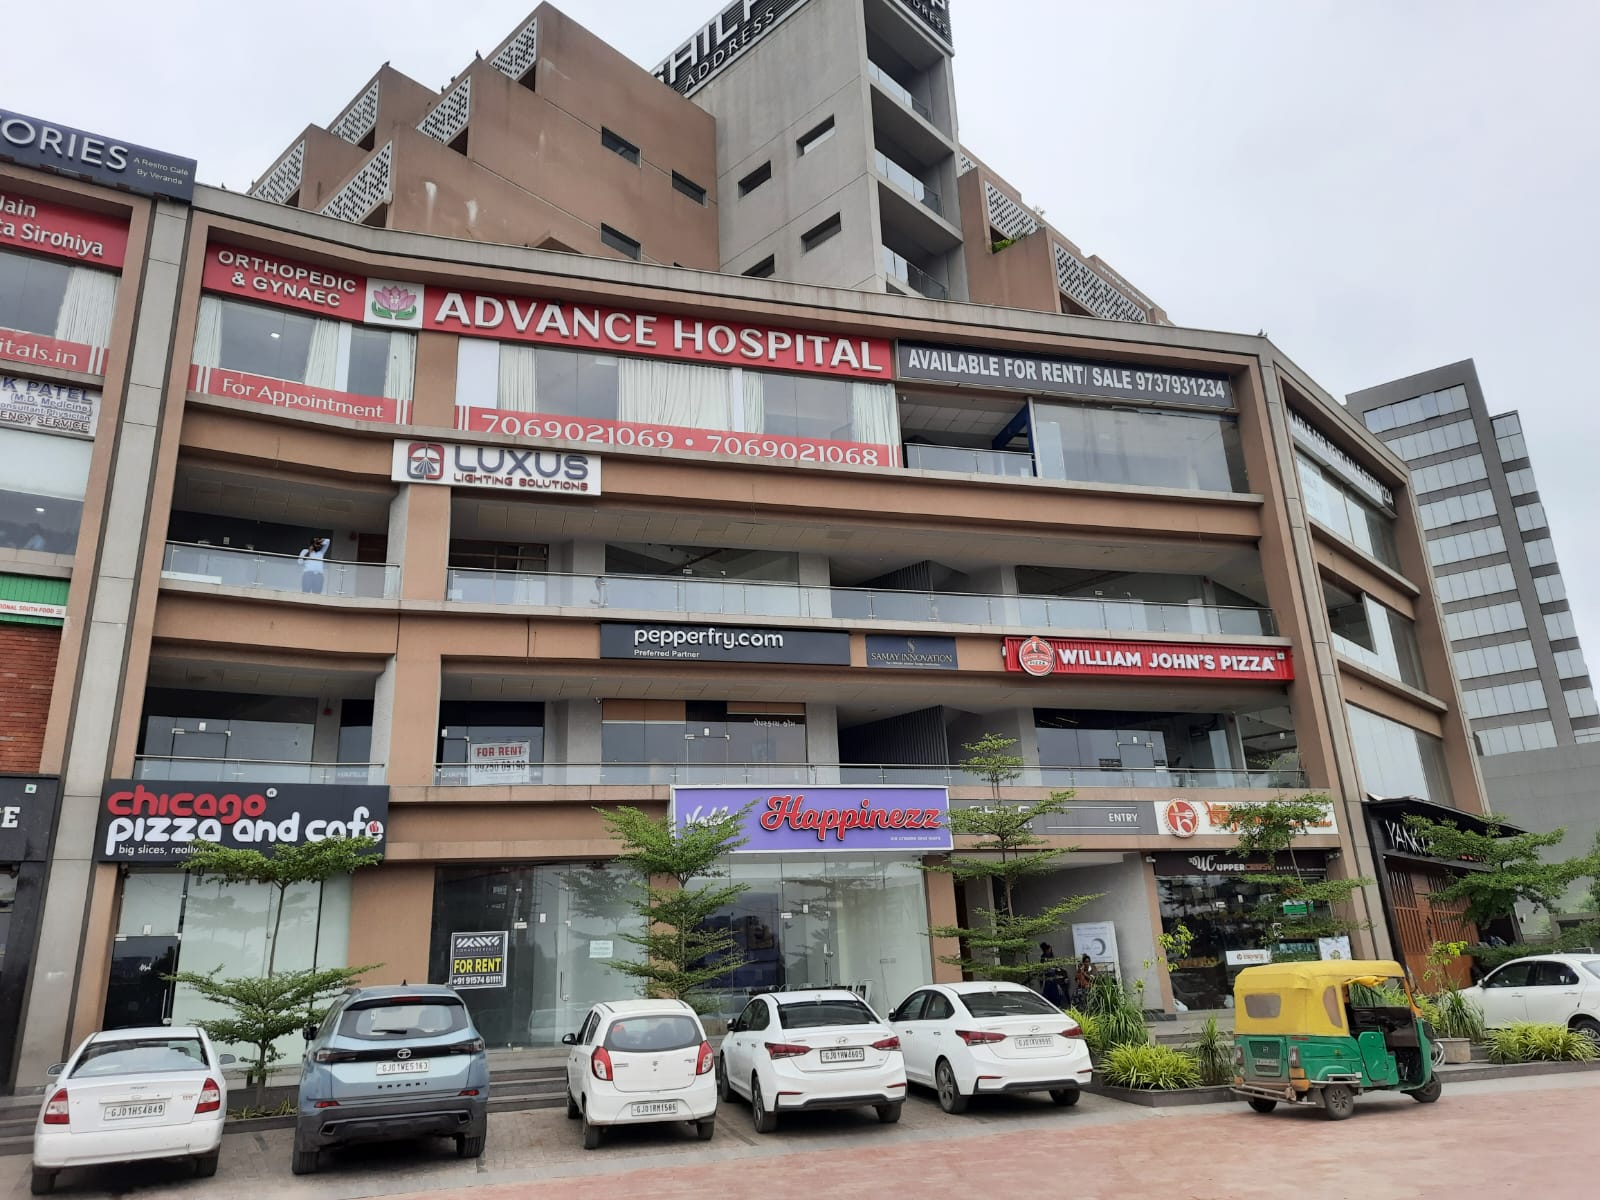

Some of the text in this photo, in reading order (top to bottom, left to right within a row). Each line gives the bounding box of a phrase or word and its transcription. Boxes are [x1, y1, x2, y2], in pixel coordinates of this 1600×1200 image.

[685, 7, 775, 91] ADDRESS
[137, 168, 183, 185] By Veranda
[21, 223, 104, 257] Sirohiya
[218, 250, 357, 294] ORTHOPEDIC
[231, 271, 341, 307] & GYNAEC
[434, 292, 883, 372] ADVANCE HOSPITAL
[908, 350, 1000, 377] AVAILABLE
[1004, 358, 1038, 380] FOR
[1092, 367, 1133, 390] SALE
[1136, 372, 1225, 398] 9737931234
[27, 380, 92, 402] PATEL
[222, 378, 384, 418] For Appointment
[37, 415, 89, 432] SERVICE
[481, 414, 878, 466] 7069021069 7069021068
[455, 446, 589, 480] LUXUS
[453, 472, 589, 491] LIGHTING SOLUTIONS
[634, 628, 784, 649] pepperfry.com
[634, 649, 700, 658] Preferred Partner
[871, 652, 953, 663] SAMAY INNOVATION
[1058, 648, 1276, 671] WILLIAM JOHN'S PIZZA
[477, 745, 523, 757] FOR RENT
[107, 784, 267, 824] chicago
[760, 794, 943, 842] Happinezz
[1108, 812, 1139, 823] ENTRY
[105, 817, 222, 855] pizza
[232, 811, 301, 842] and
[119, 844, 135, 856] big
[138, 844, 168, 856] slices,
[453, 957, 502, 974] FOR RENT
[453, 977, 465, 985] +91
[466, 976, 485, 985] 91574
